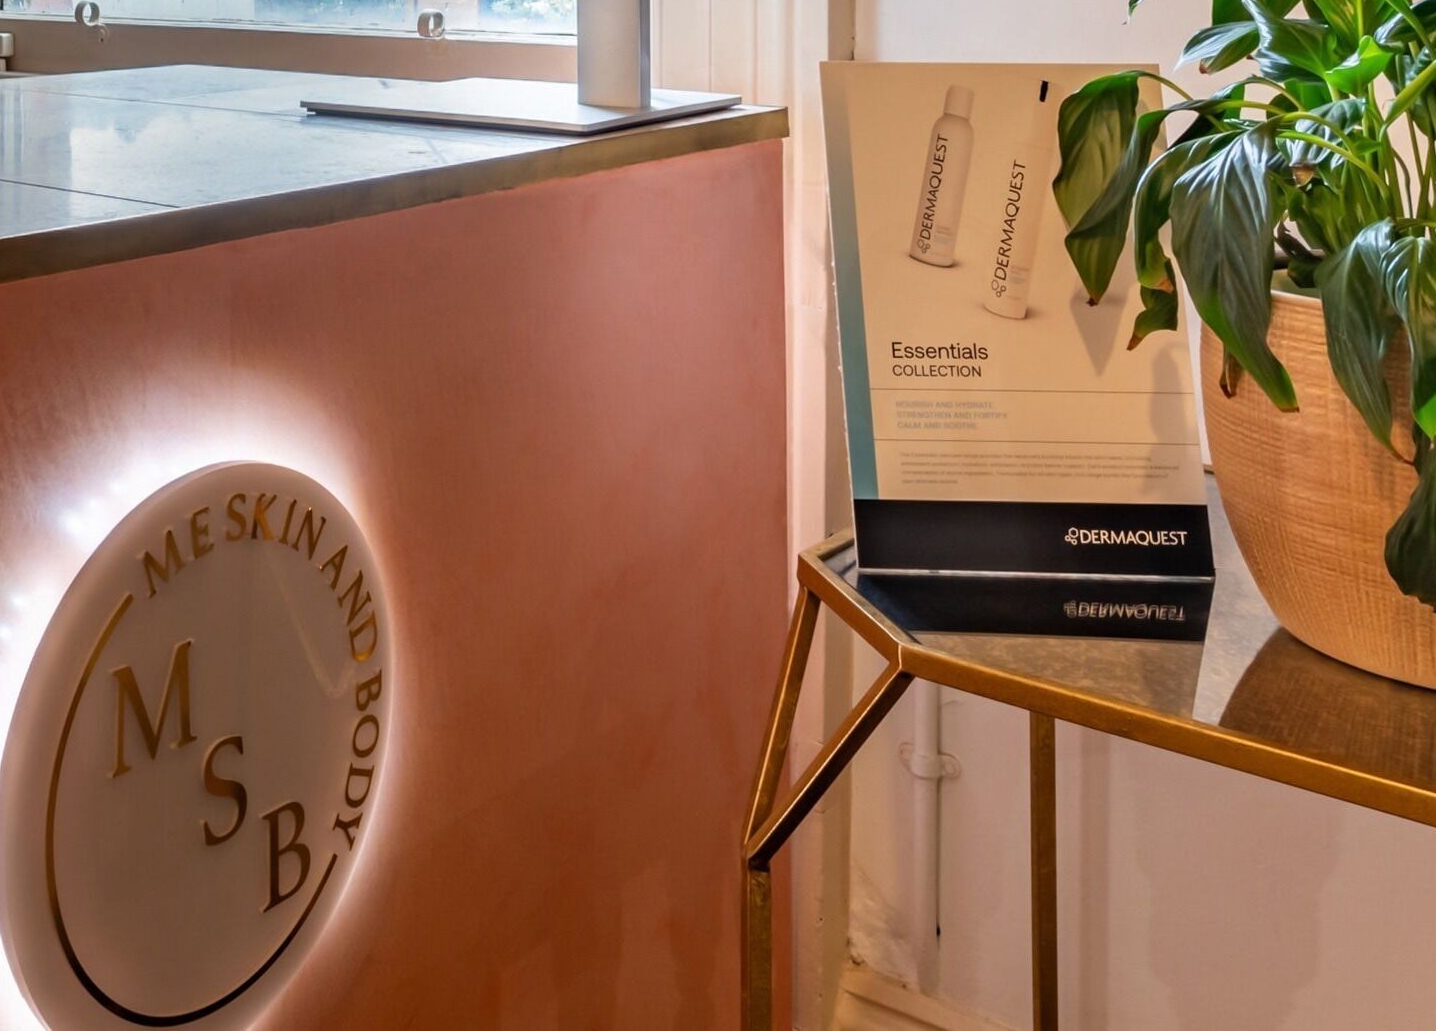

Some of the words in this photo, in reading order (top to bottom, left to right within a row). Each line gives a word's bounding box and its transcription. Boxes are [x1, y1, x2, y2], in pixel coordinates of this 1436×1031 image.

[919, 134, 948, 240] DERMAQUEST
[994, 159, 1026, 281] DERMAQUEST
[891, 341, 989, 360] Essentials
[892, 364, 982, 377] COLLECTION
[137, 506, 216, 600] ME
[225, 492, 328, 561] SKIN
[1079, 529, 1188, 546] DERMAQUEST
[320, 544, 379, 662] AND
[332, 668, 383, 851] BODY
